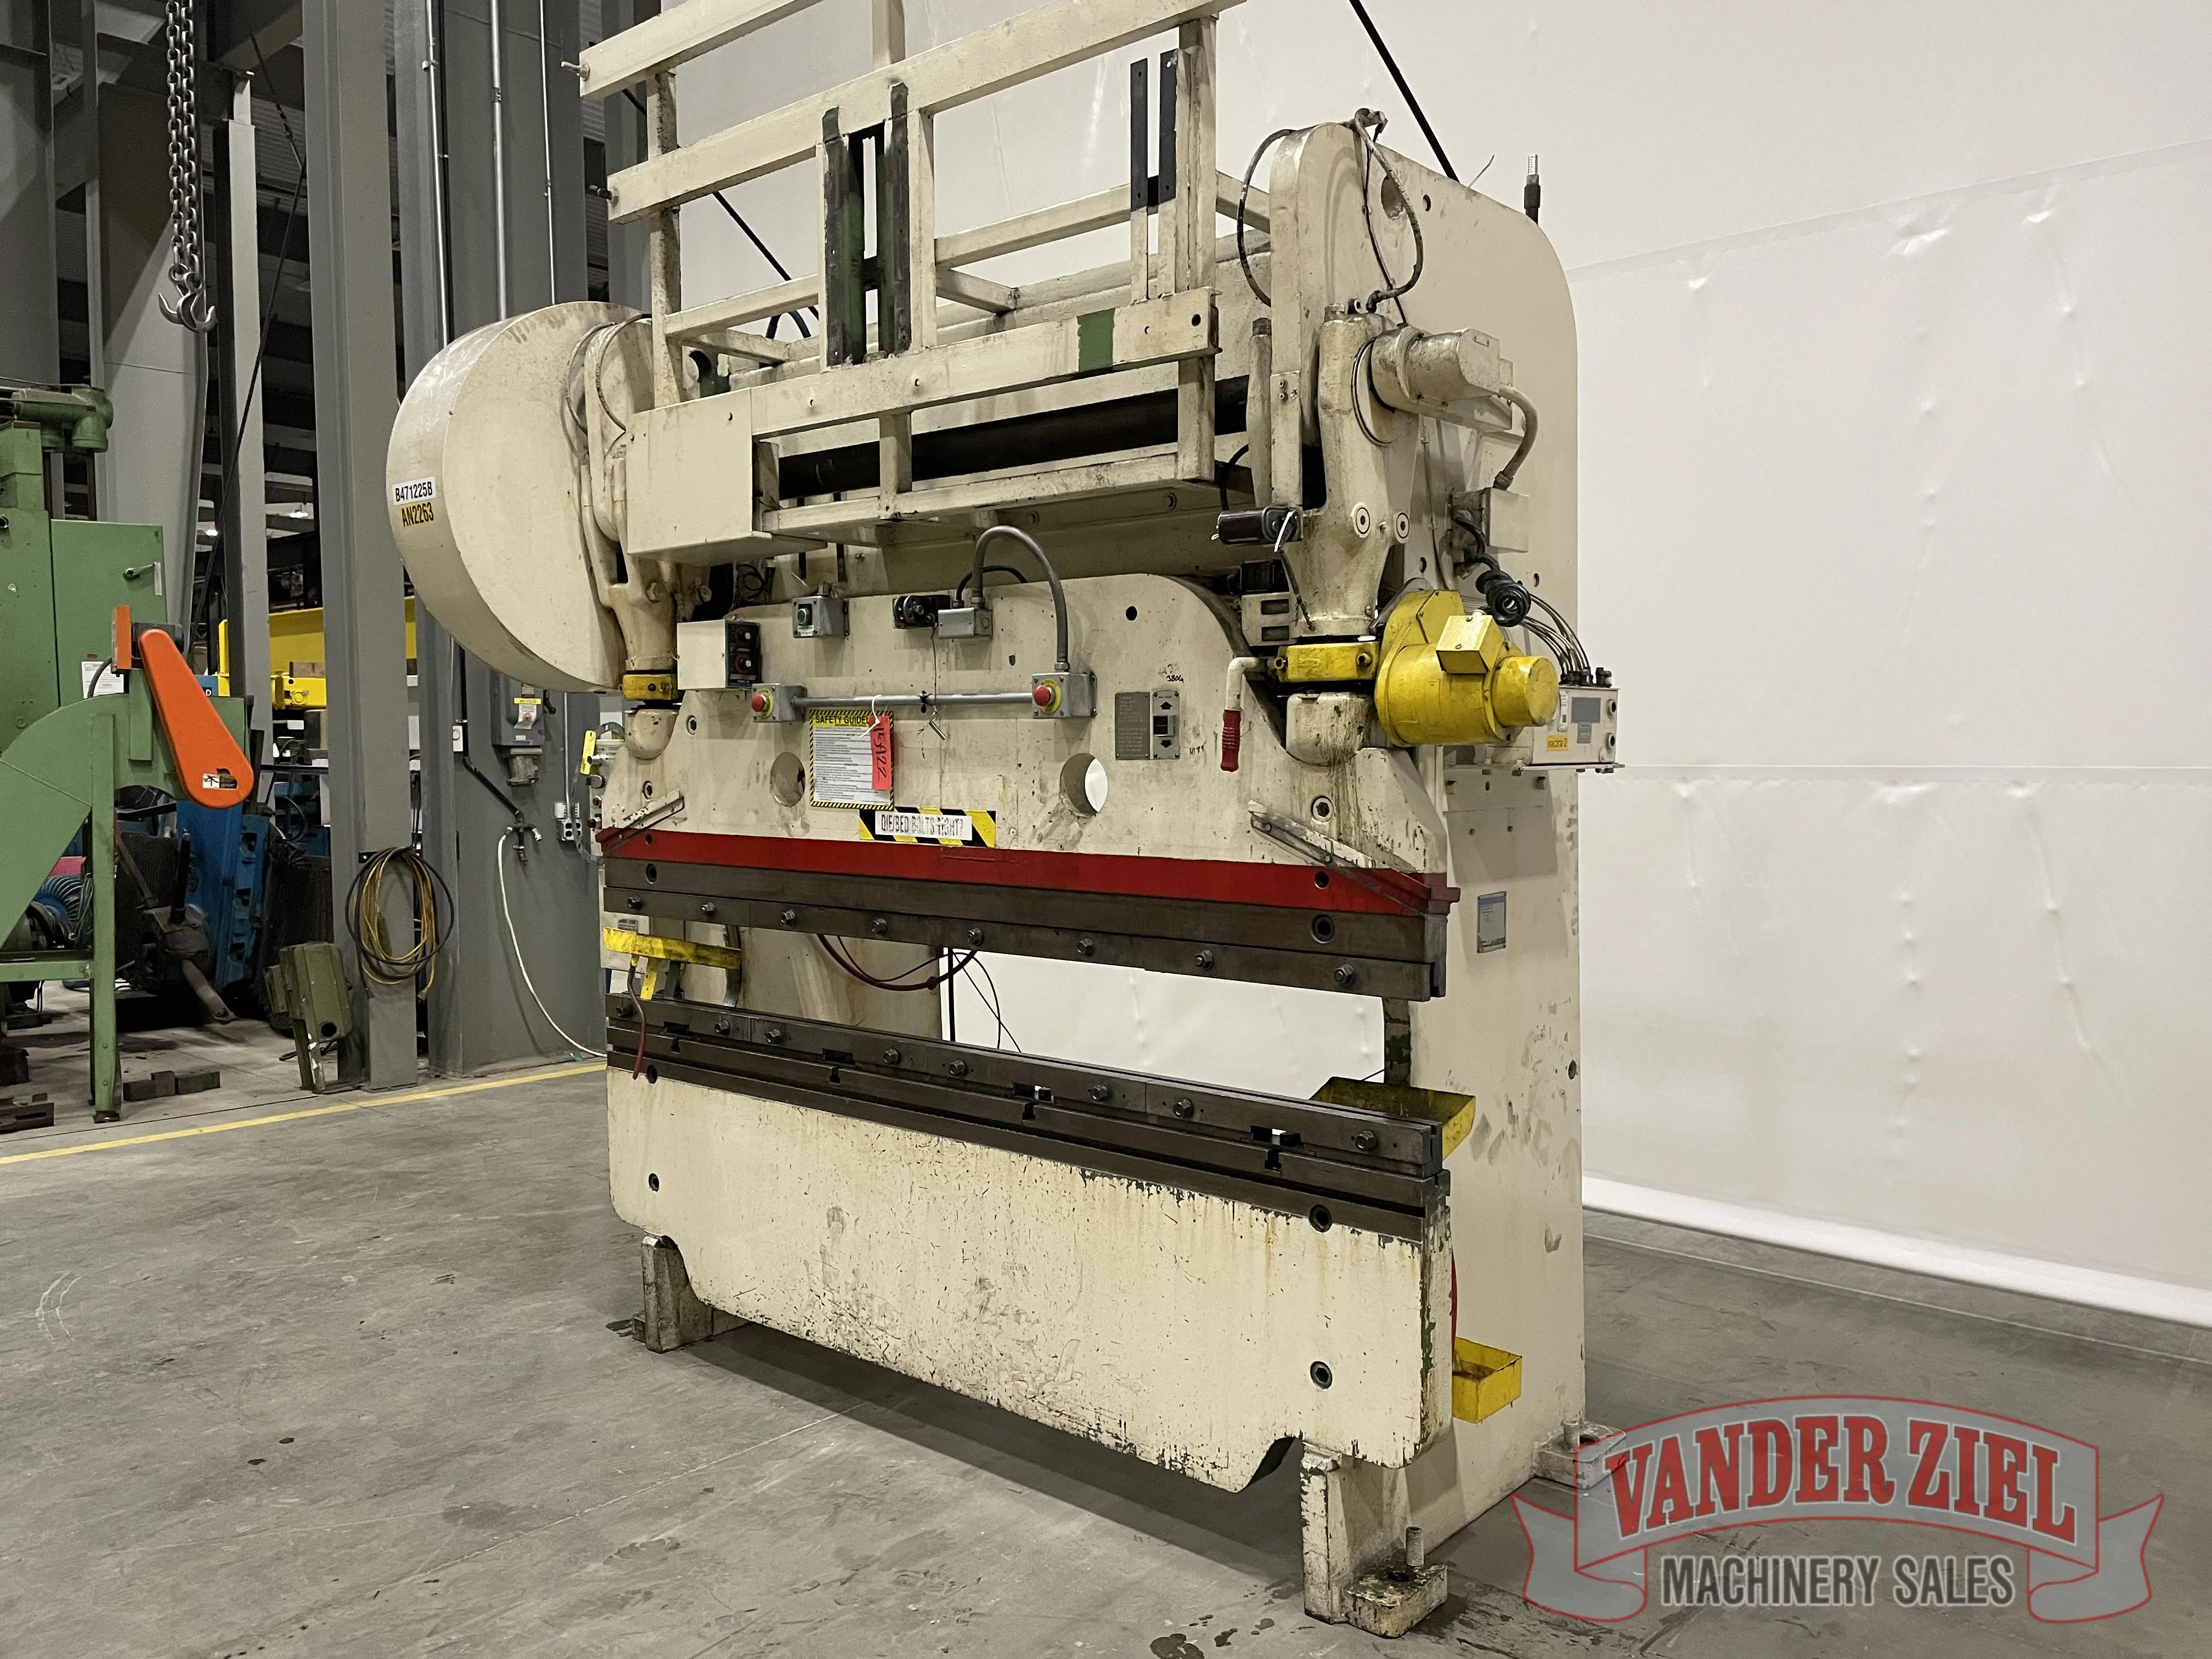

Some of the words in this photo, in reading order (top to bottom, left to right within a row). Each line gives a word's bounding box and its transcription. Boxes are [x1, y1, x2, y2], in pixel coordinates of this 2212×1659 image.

[396, 481, 432, 502] B471225B
[402, 501, 434, 527] AN2263
[815, 715, 842, 724] SAFETY
[844, 715, 870, 724] GUIDEL
